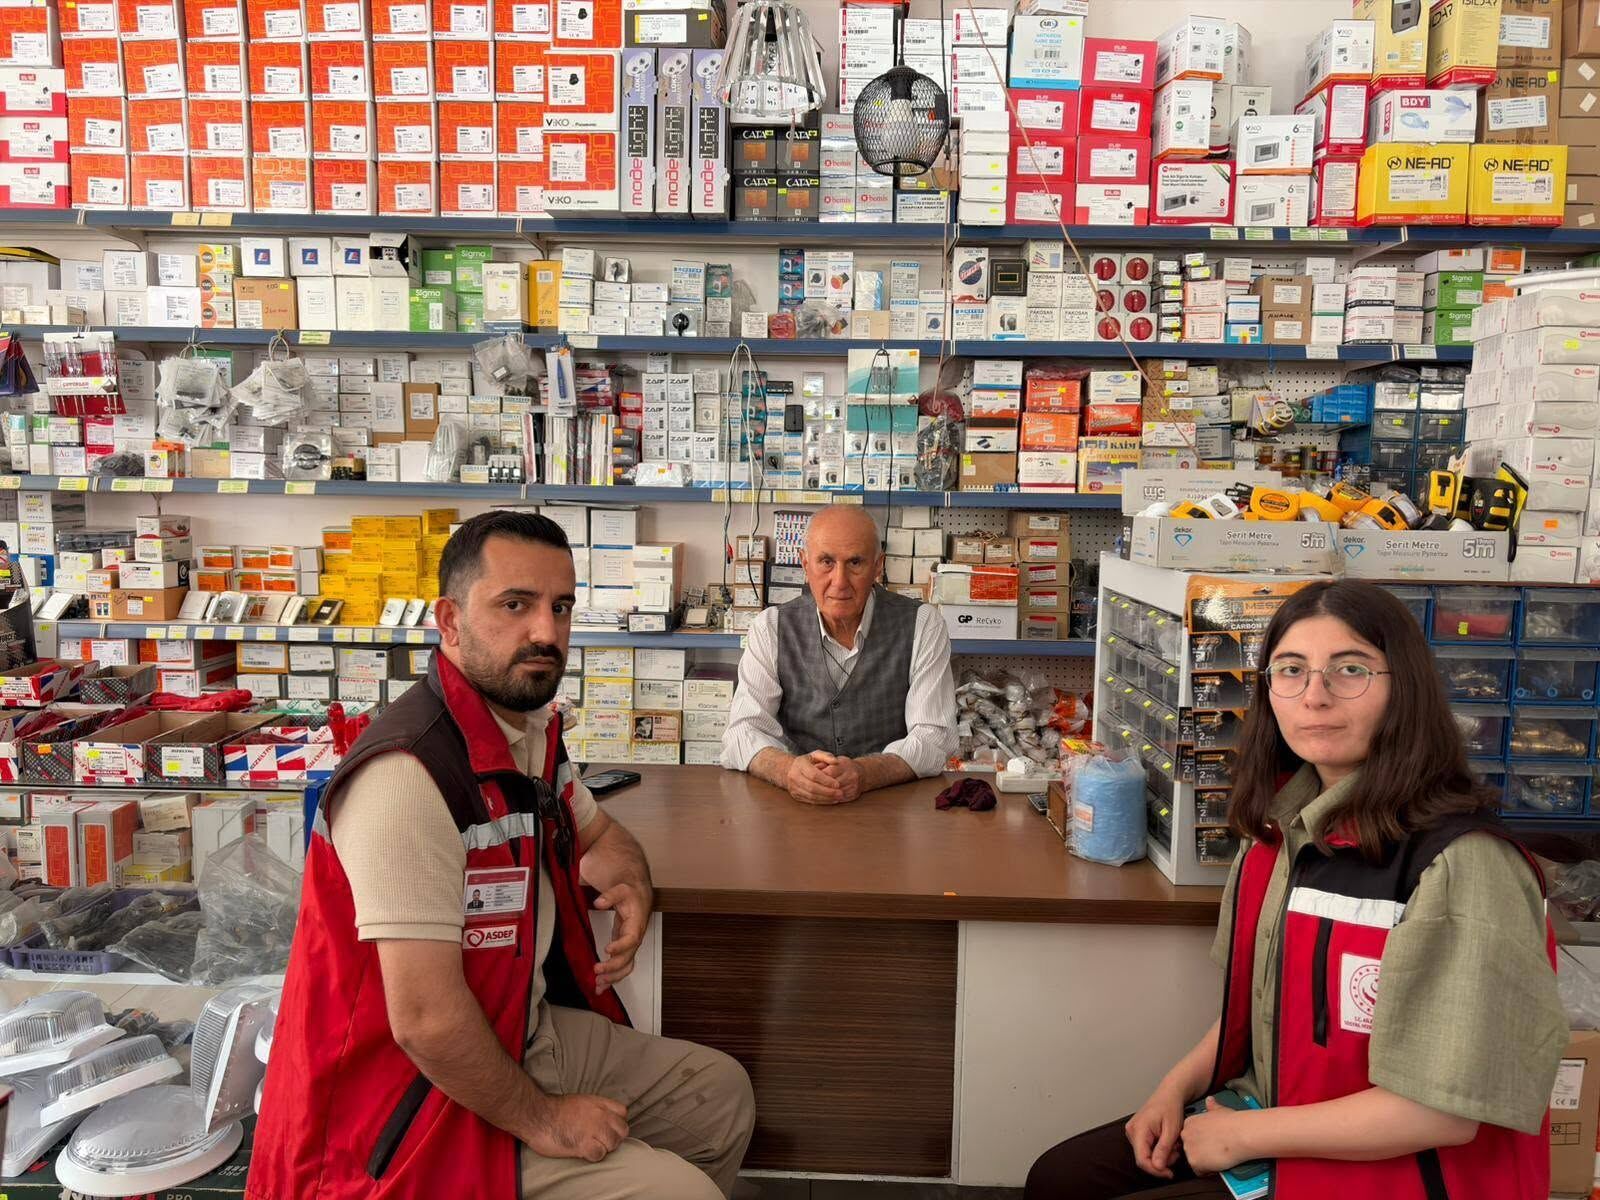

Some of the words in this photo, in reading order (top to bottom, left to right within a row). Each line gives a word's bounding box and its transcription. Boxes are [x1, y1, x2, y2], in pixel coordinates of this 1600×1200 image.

[1506, 76, 1547, 88] NE-AD
[1401, 97, 1426, 107] BDY
[545, 118, 570, 127] VIKO
[1292, 123, 1300, 133] 6
[742, 130, 767, 139] CATA
[832, 159, 852, 167] bemis
[1405, 157, 1452, 170] NE-AD
[1502, 159, 1551, 172] NE-AD
[744, 178, 768, 187] CATA
[786, 178, 811, 187] CATA
[1287, 184, 1294, 194] 6
[548, 196, 572, 205] VIKO
[831, 196, 851, 204] bemis
[867, 194, 888, 202] bemis
[1219, 198, 1225, 207] 8
[462, 250, 486, 259] Sigma
[1451, 274, 1473, 283] Sigma
[415, 289, 441, 298] Sigma
[463, 296, 483, 305] Sigm
[1448, 312, 1472, 321] Sigma
[1249, 531, 1273, 540] Metre
[1411, 540, 1440, 550] Metre
[958, 614, 973, 624] GP
[976, 616, 1002, 625] ReCyko
[1230, 623, 1262, 631] CARBON
[1199, 732, 1206, 741] 2
[1199, 771, 1206, 779] 2
[1200, 809, 1206, 818] 2
[485, 929, 514, 941] ASDEP
